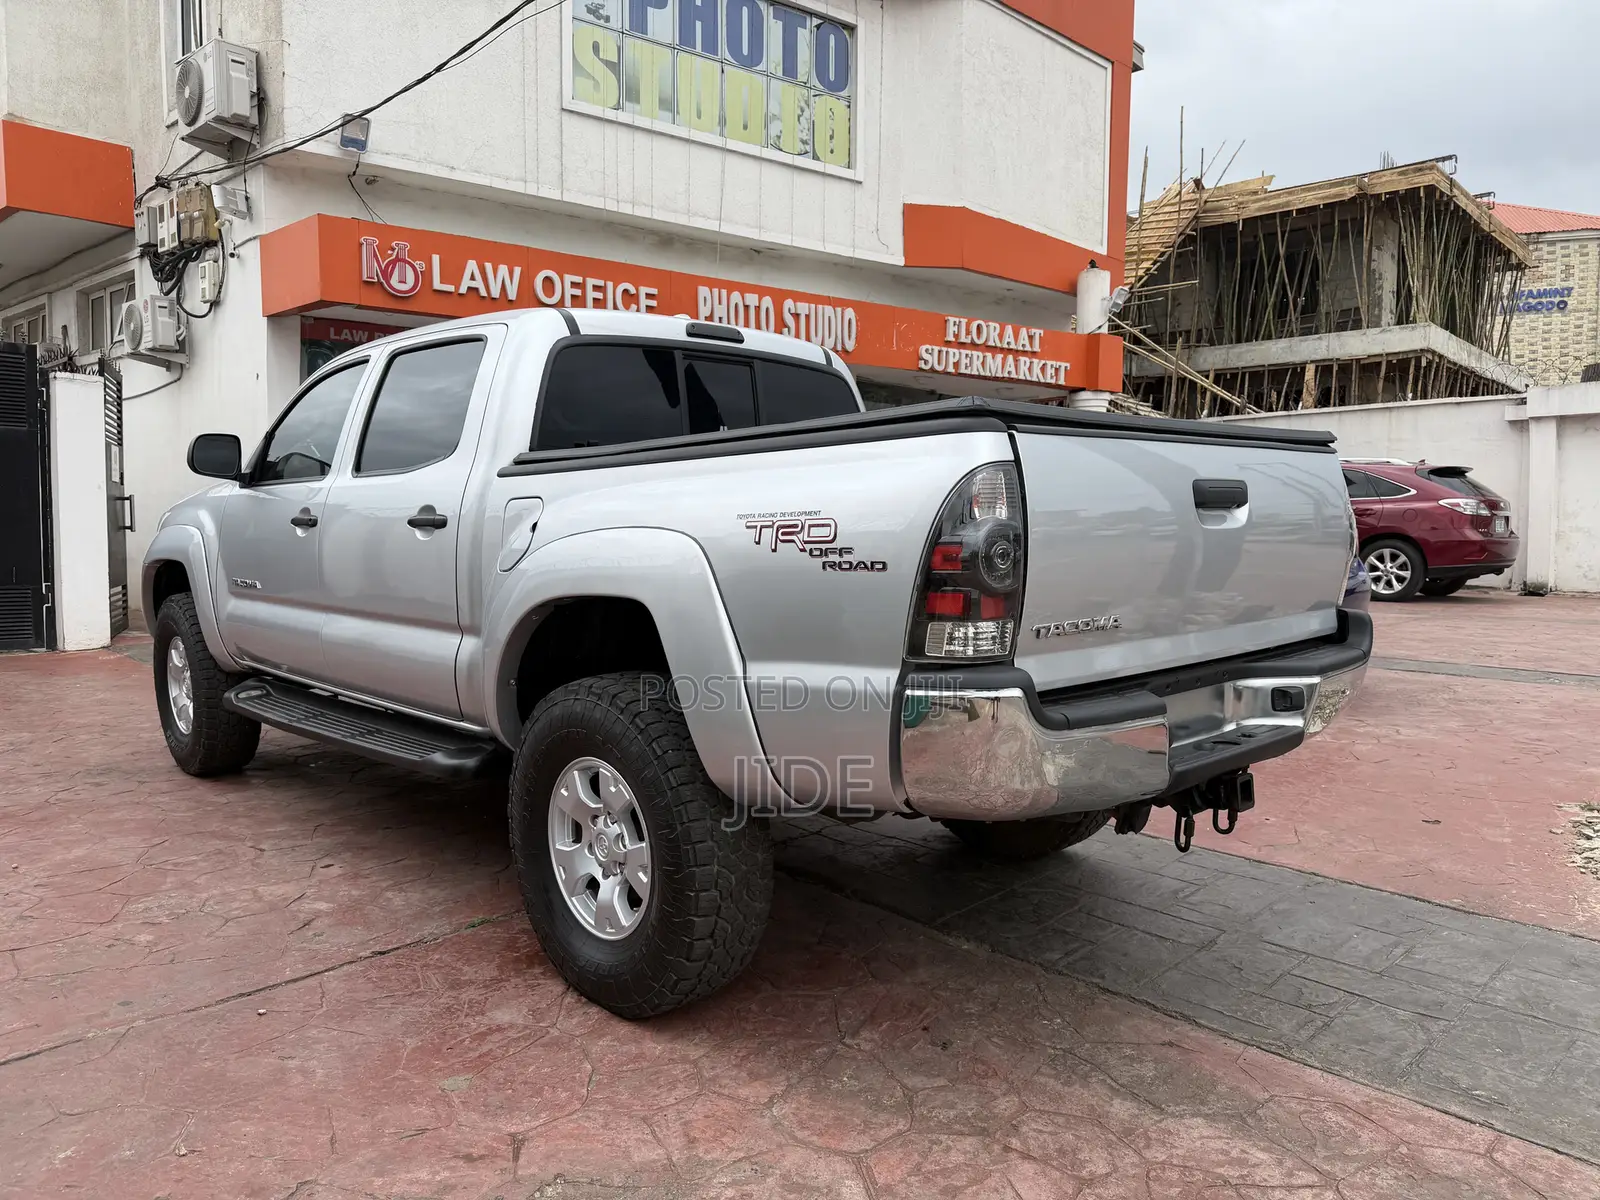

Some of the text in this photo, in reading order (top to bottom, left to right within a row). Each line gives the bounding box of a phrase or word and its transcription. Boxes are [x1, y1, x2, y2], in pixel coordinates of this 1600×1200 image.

[572, 19, 851, 168] STUDIO
[431, 254, 522, 301] LAW
[534, 269, 658, 313] OFFICE
[329, 327, 368, 341] LAW
[697, 285, 857, 352] PHOTO STUDIO
[944, 316, 1044, 352] FLORAAT
[918, 344, 1070, 385] SUPERMARKET
[779, 510, 822, 518] DEVELOPMENT
[745, 517, 838, 553] TRD
[808, 547, 854, 559] OFF
[821, 560, 888, 572] ROAD
[1031, 614, 1122, 639] TACOMA
